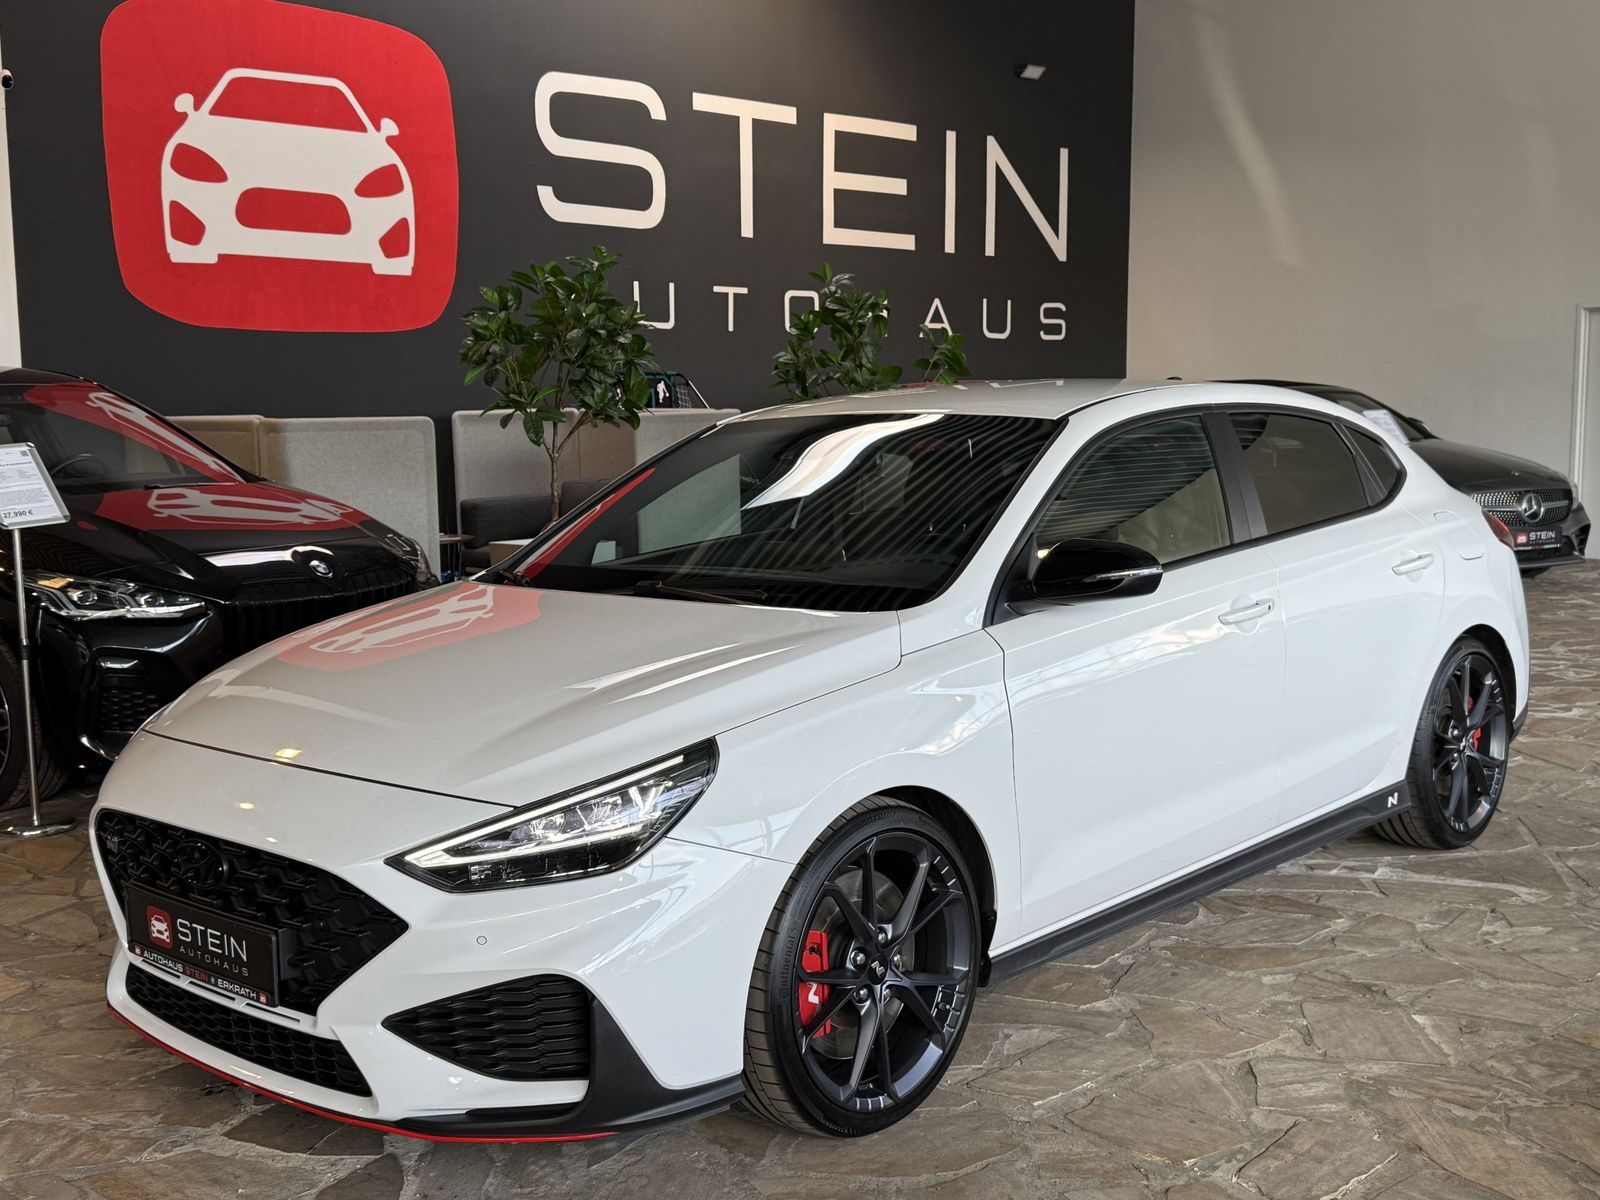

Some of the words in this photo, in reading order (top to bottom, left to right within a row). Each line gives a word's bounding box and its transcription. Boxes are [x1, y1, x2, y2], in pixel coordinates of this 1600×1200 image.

[534, 71, 1069, 262] STEIN
[633, 280, 1068, 341] UTOAUS
[1529, 530, 1556, 541] STEIN
[1387, 792, 1399, 808] N
[176, 918, 248, 963] STEIN
[179, 945, 249, 977] AUTOHAUS
[143, 950, 184, 973] AUTOHAUS
[184, 966, 209, 982] STEIN
[216, 978, 258, 1000] ERKRATH
